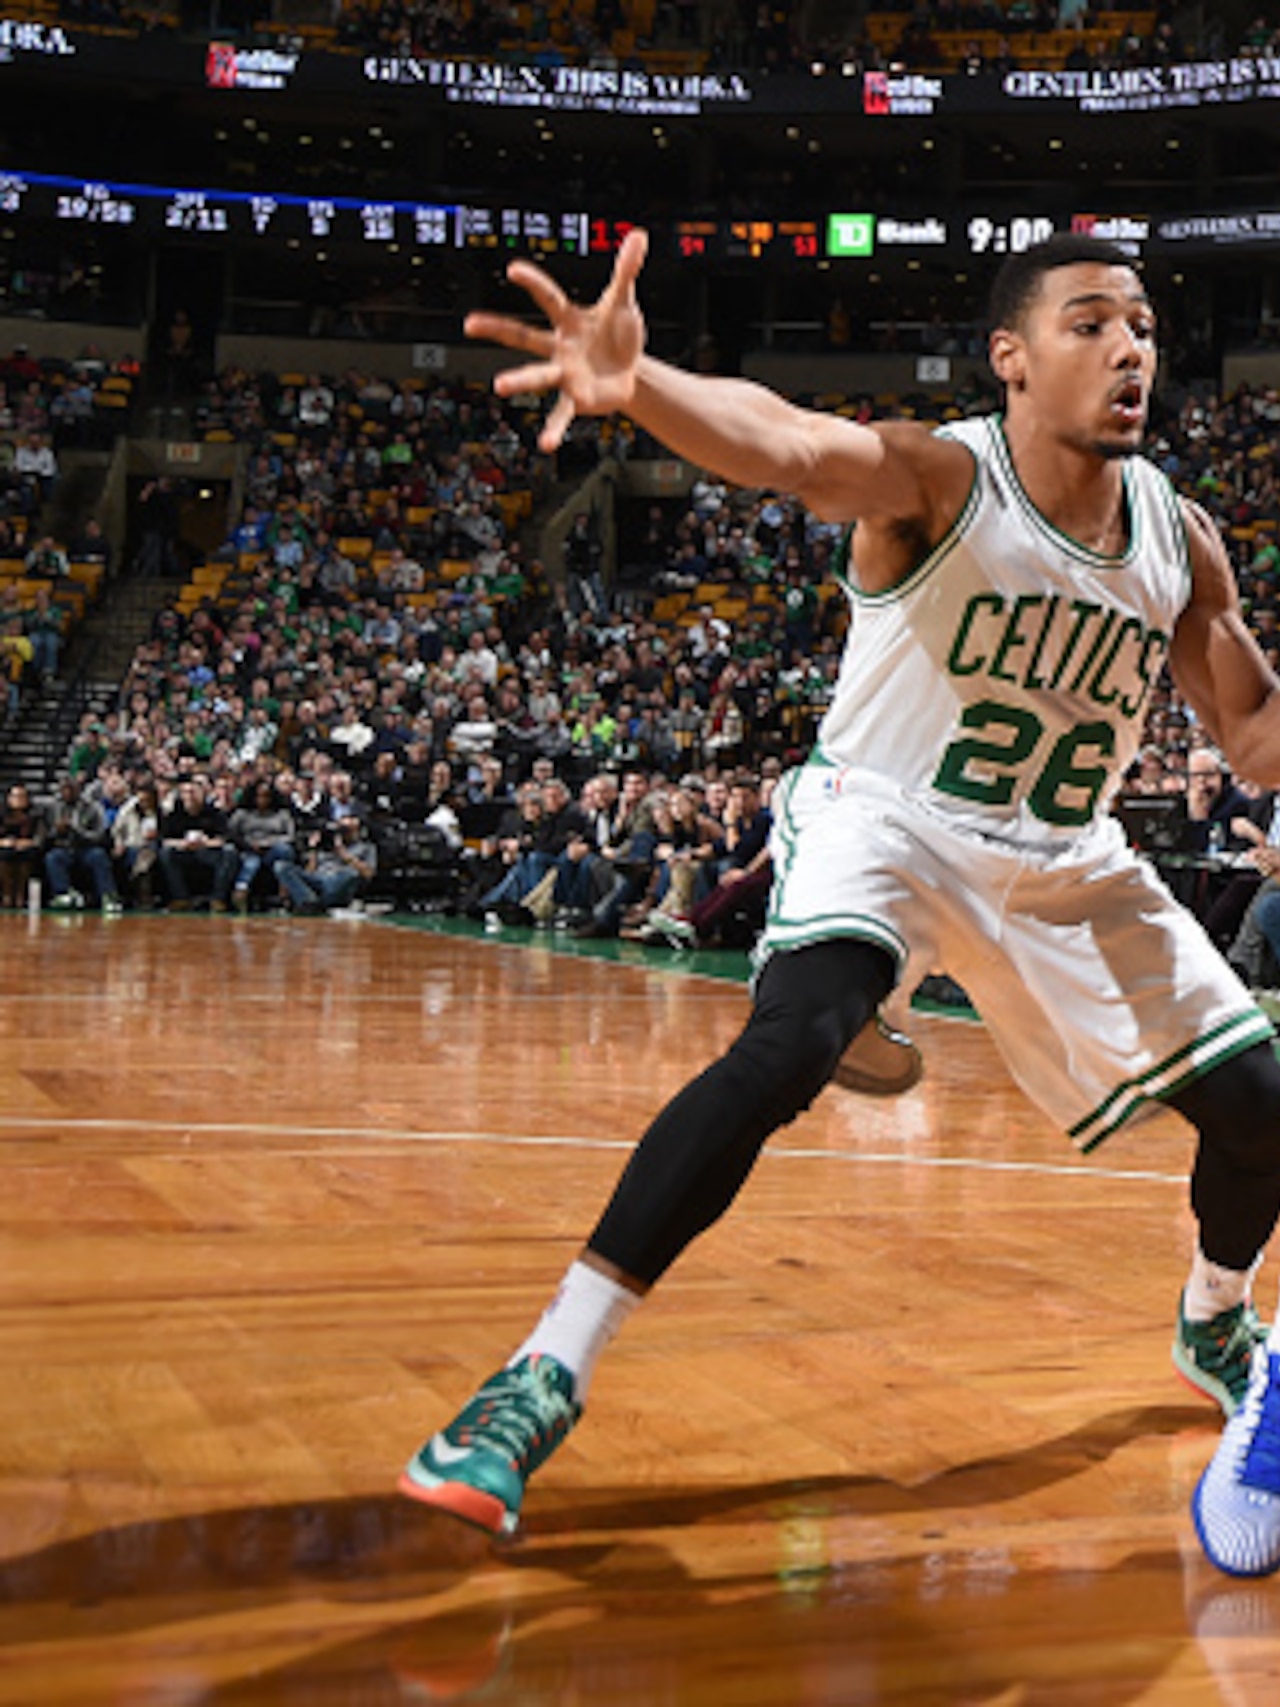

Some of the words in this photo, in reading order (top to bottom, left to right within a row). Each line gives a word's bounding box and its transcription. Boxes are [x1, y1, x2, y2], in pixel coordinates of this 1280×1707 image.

[878, 217, 946, 244] Bank
[948, 591, 1167, 718] CELTICS
[931, 700, 1116, 826] 26
